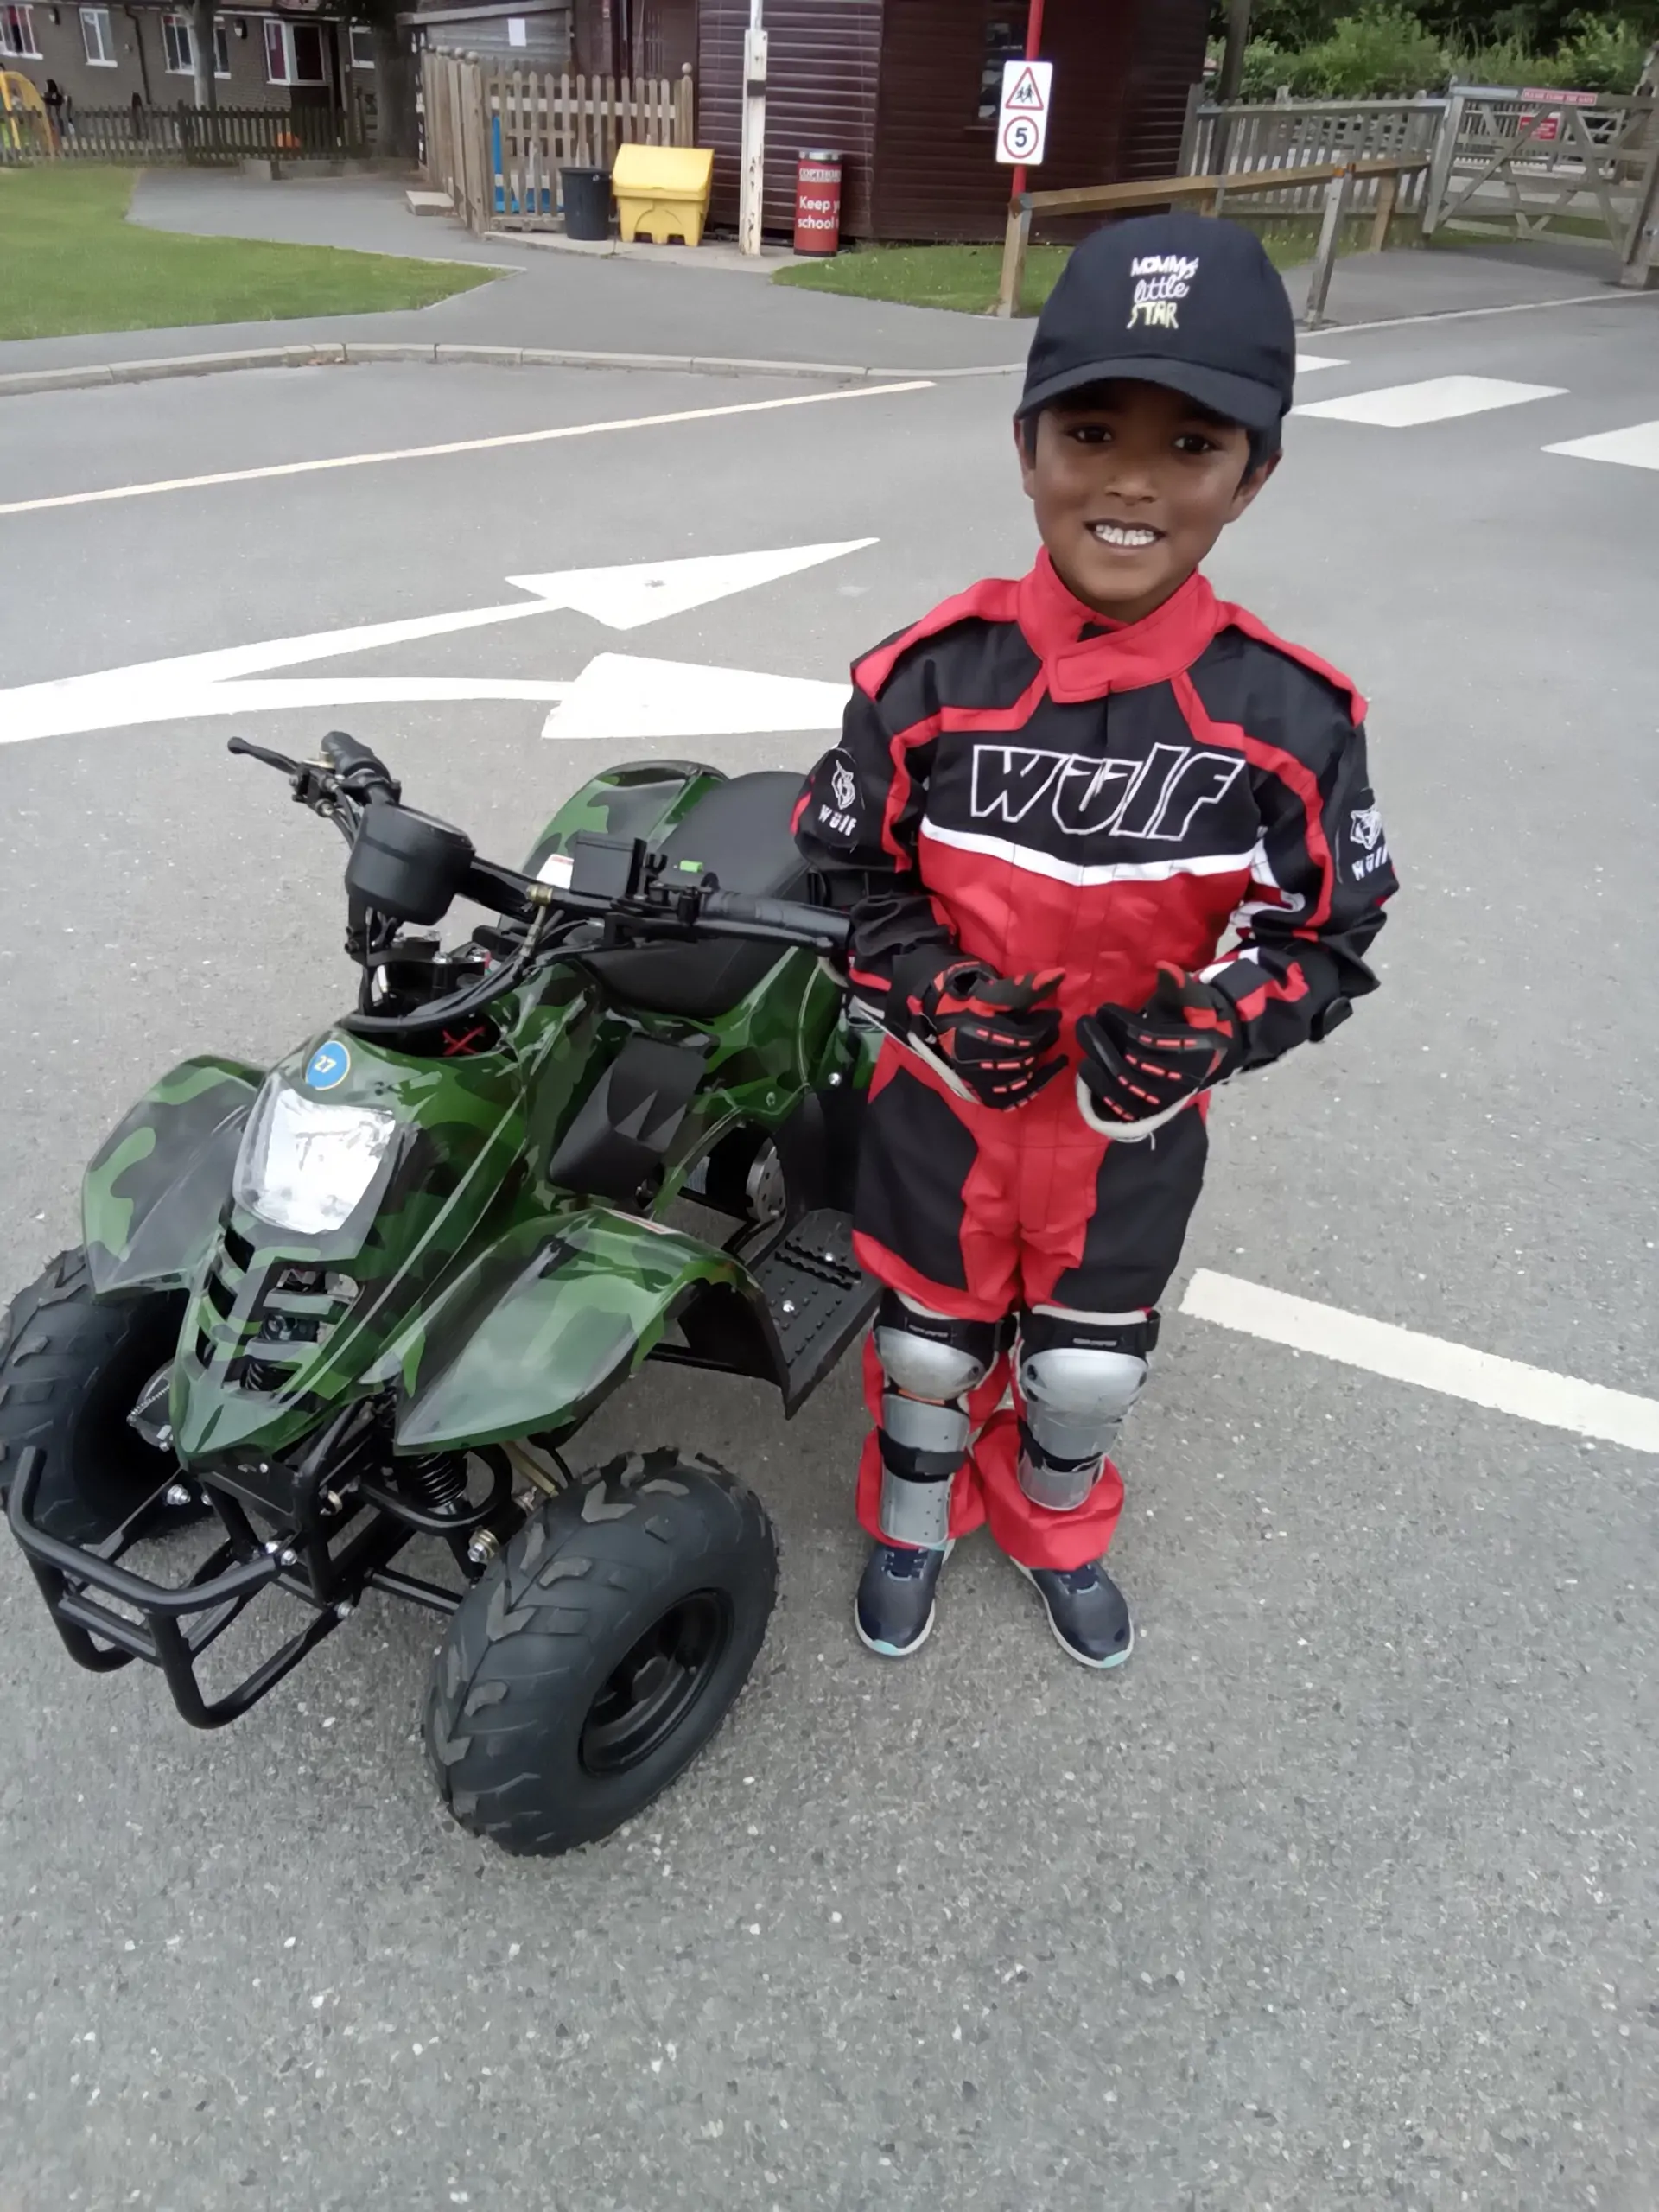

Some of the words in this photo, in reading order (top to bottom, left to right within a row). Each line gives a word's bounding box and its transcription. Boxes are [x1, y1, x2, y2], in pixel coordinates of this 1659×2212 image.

[1014, 127, 1028, 148] 5
[799, 195, 831, 213] Keep
[798, 214, 835, 230] school
[1126, 300, 1179, 329] STAR
[314, 1054, 337, 1074] 27
